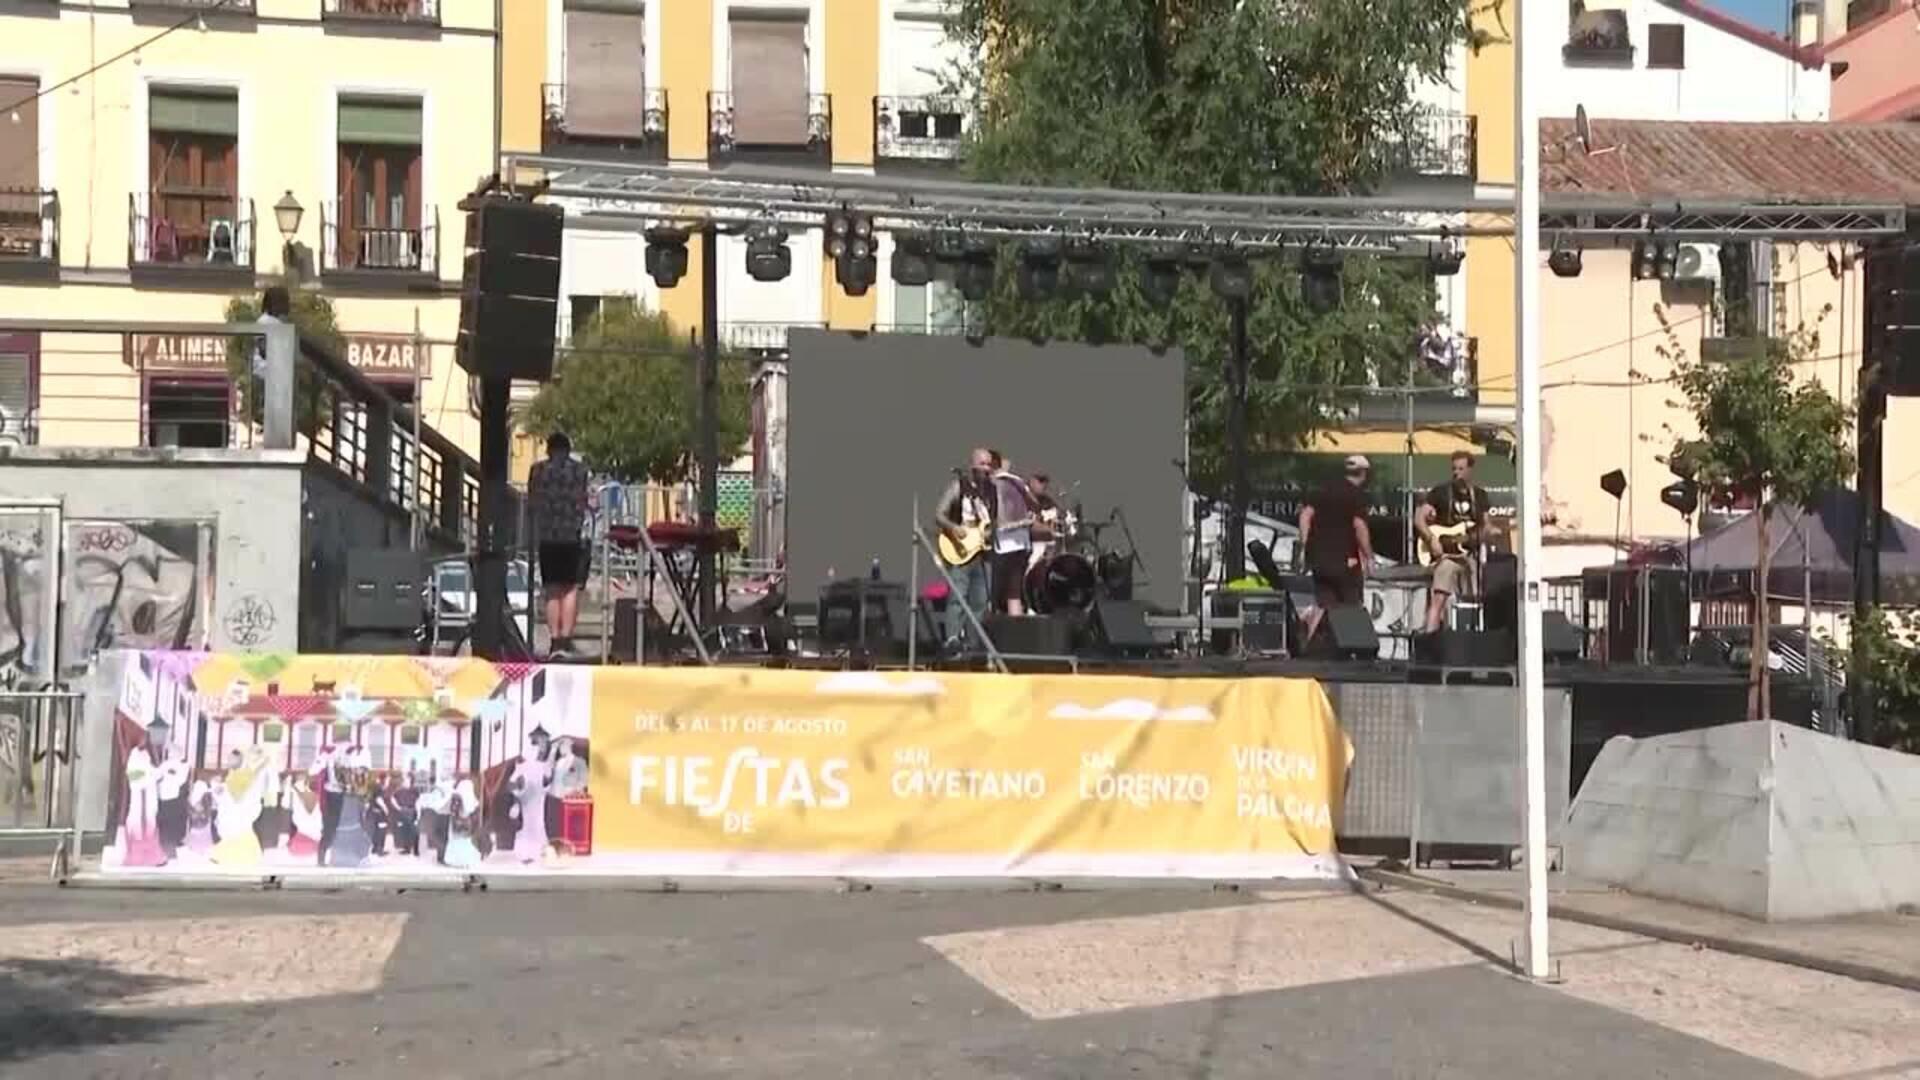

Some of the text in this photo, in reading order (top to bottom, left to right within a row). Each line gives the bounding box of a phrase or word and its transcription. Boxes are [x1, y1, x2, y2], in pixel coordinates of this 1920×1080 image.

[348, 342, 415, 368] BAZAR
[634, 713, 669, 733] DEL
[689, 717, 710, 734] AL
[719, 715, 738, 734] 17
[742, 716, 769, 734] DE
[771, 718, 848, 735] AGOSTO
[893, 747, 930, 768] SAN
[1079, 752, 1117, 769] SAN
[629, 746, 851, 817] FIESTAS
[891, 768, 1047, 800] CAYETANO
[1079, 770, 1210, 808] LORENZO
[722, 811, 757, 834] DE
[1237, 793, 1332, 829] PALOMA
